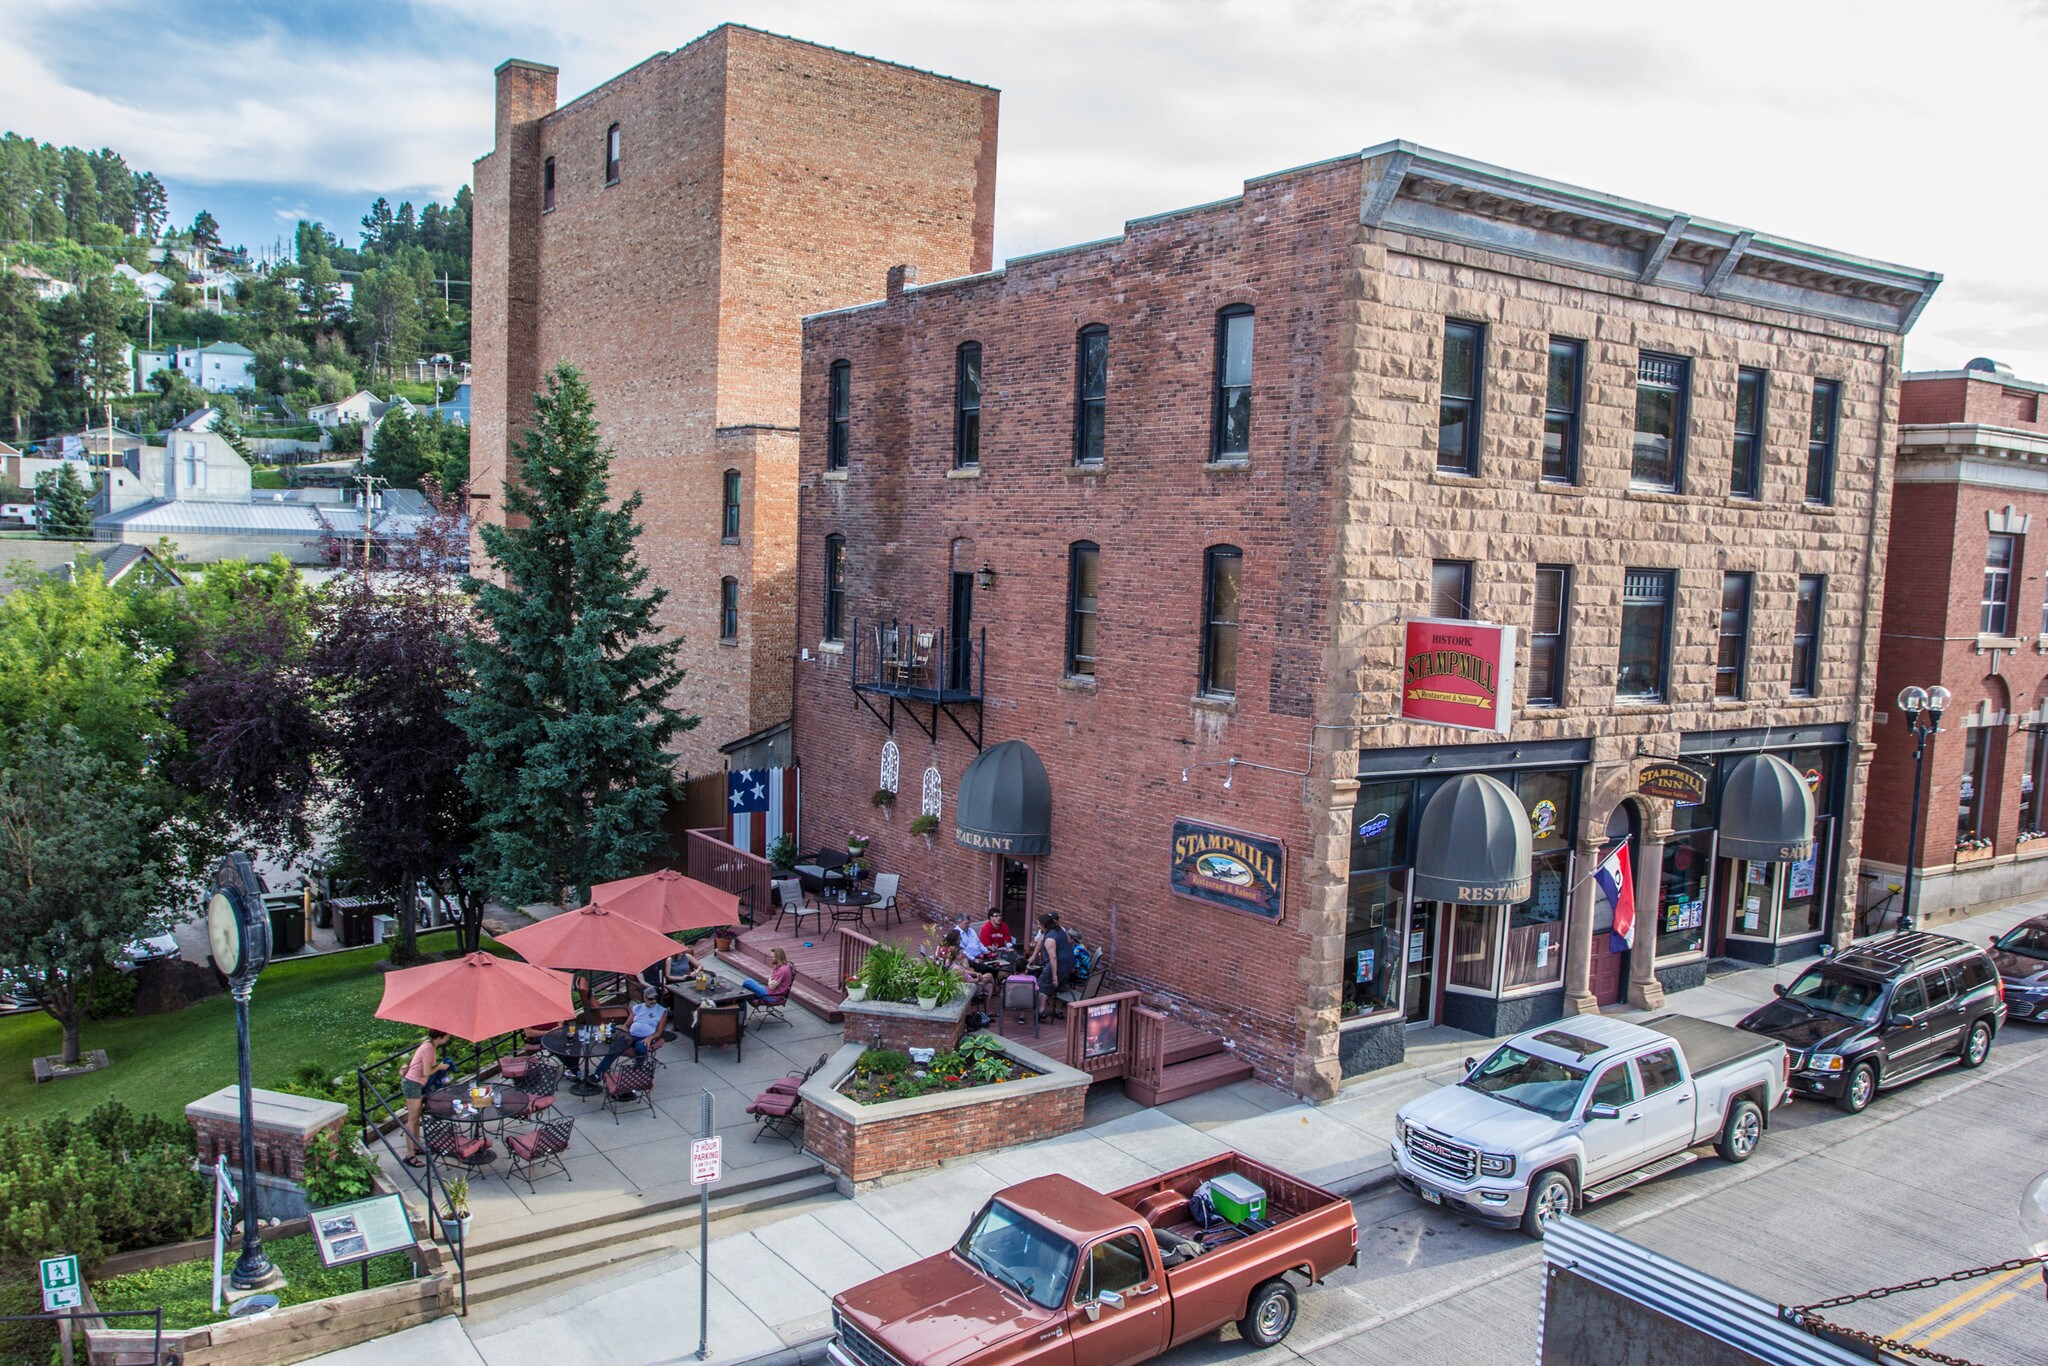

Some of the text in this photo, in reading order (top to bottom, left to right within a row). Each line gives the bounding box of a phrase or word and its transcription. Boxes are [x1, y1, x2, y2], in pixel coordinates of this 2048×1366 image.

[1432, 634, 1473, 647] HISTORIC
[1406, 650, 1496, 697] STAMPMILL
[1421, 691, 1478, 704] Restaurant & Saloon
[1639, 769, 1702, 797] STAMPMILL
[1658, 778, 1683, 790] INN
[1360, 819, 1388, 834] BUSCH
[1175, 833, 1278, 893] STAMPMILL
[1192, 874, 1257, 900] Restaurant & Saloon
[701, 1142, 717, 1151] HOUR
[1422, 1139, 1451, 1158] GMC
[694, 1151, 719, 1161] PARKING
